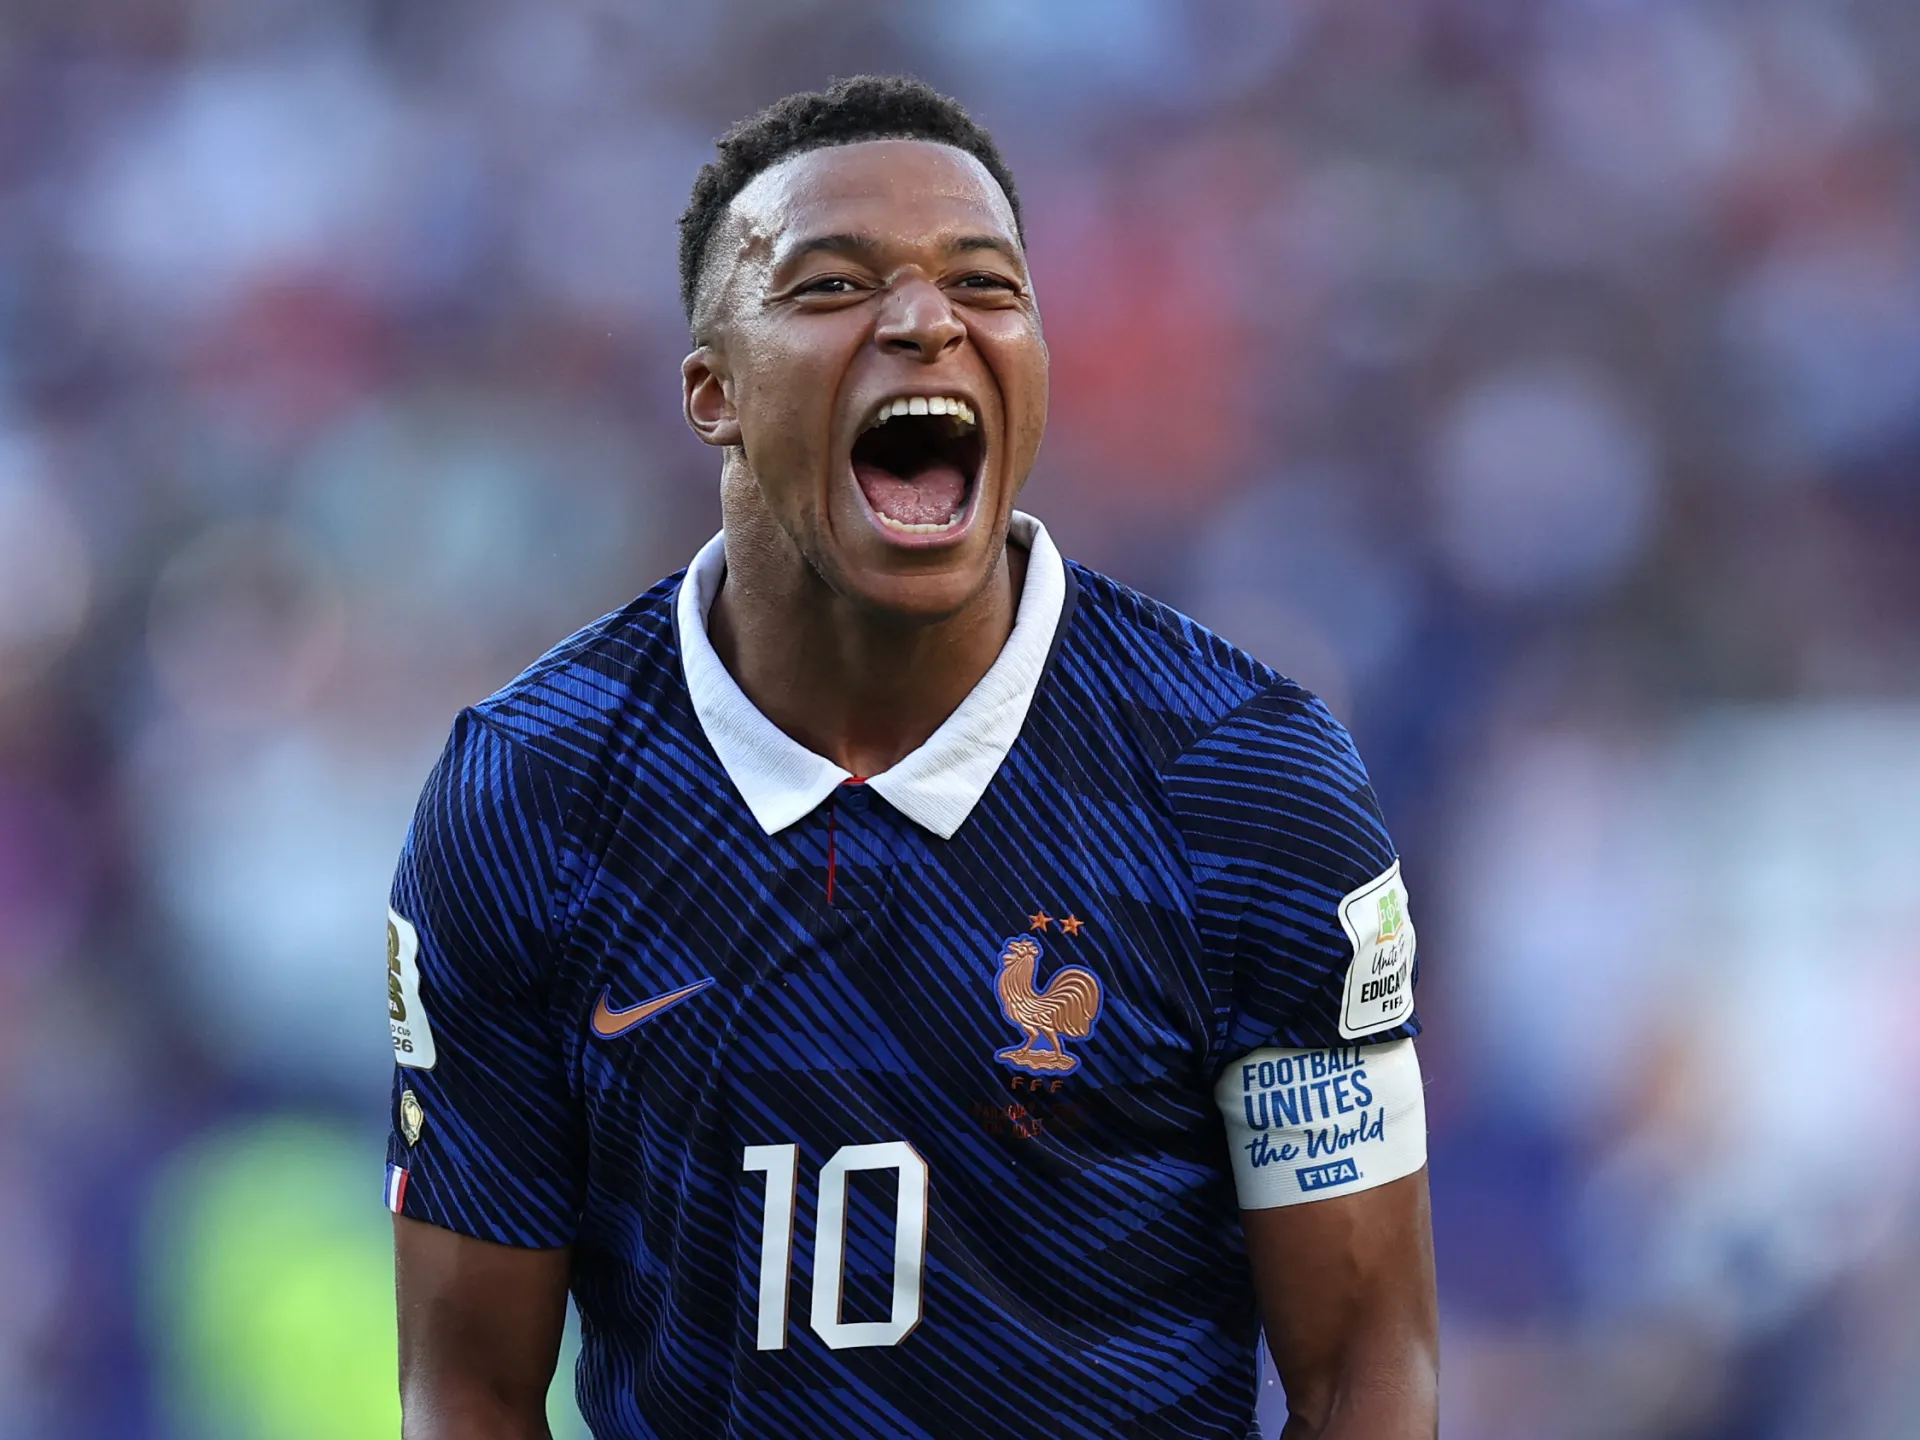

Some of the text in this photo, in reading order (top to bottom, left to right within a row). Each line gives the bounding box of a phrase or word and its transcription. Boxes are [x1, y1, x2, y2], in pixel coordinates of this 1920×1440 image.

[1242, 1045, 1365, 1091] FOOTBALL
[1244, 1070, 1373, 1131] UNITES
[1245, 1107, 1385, 1168] the World
[1303, 1164, 1355, 1186] FIFA
[743, 1141, 929, 1351] 10
